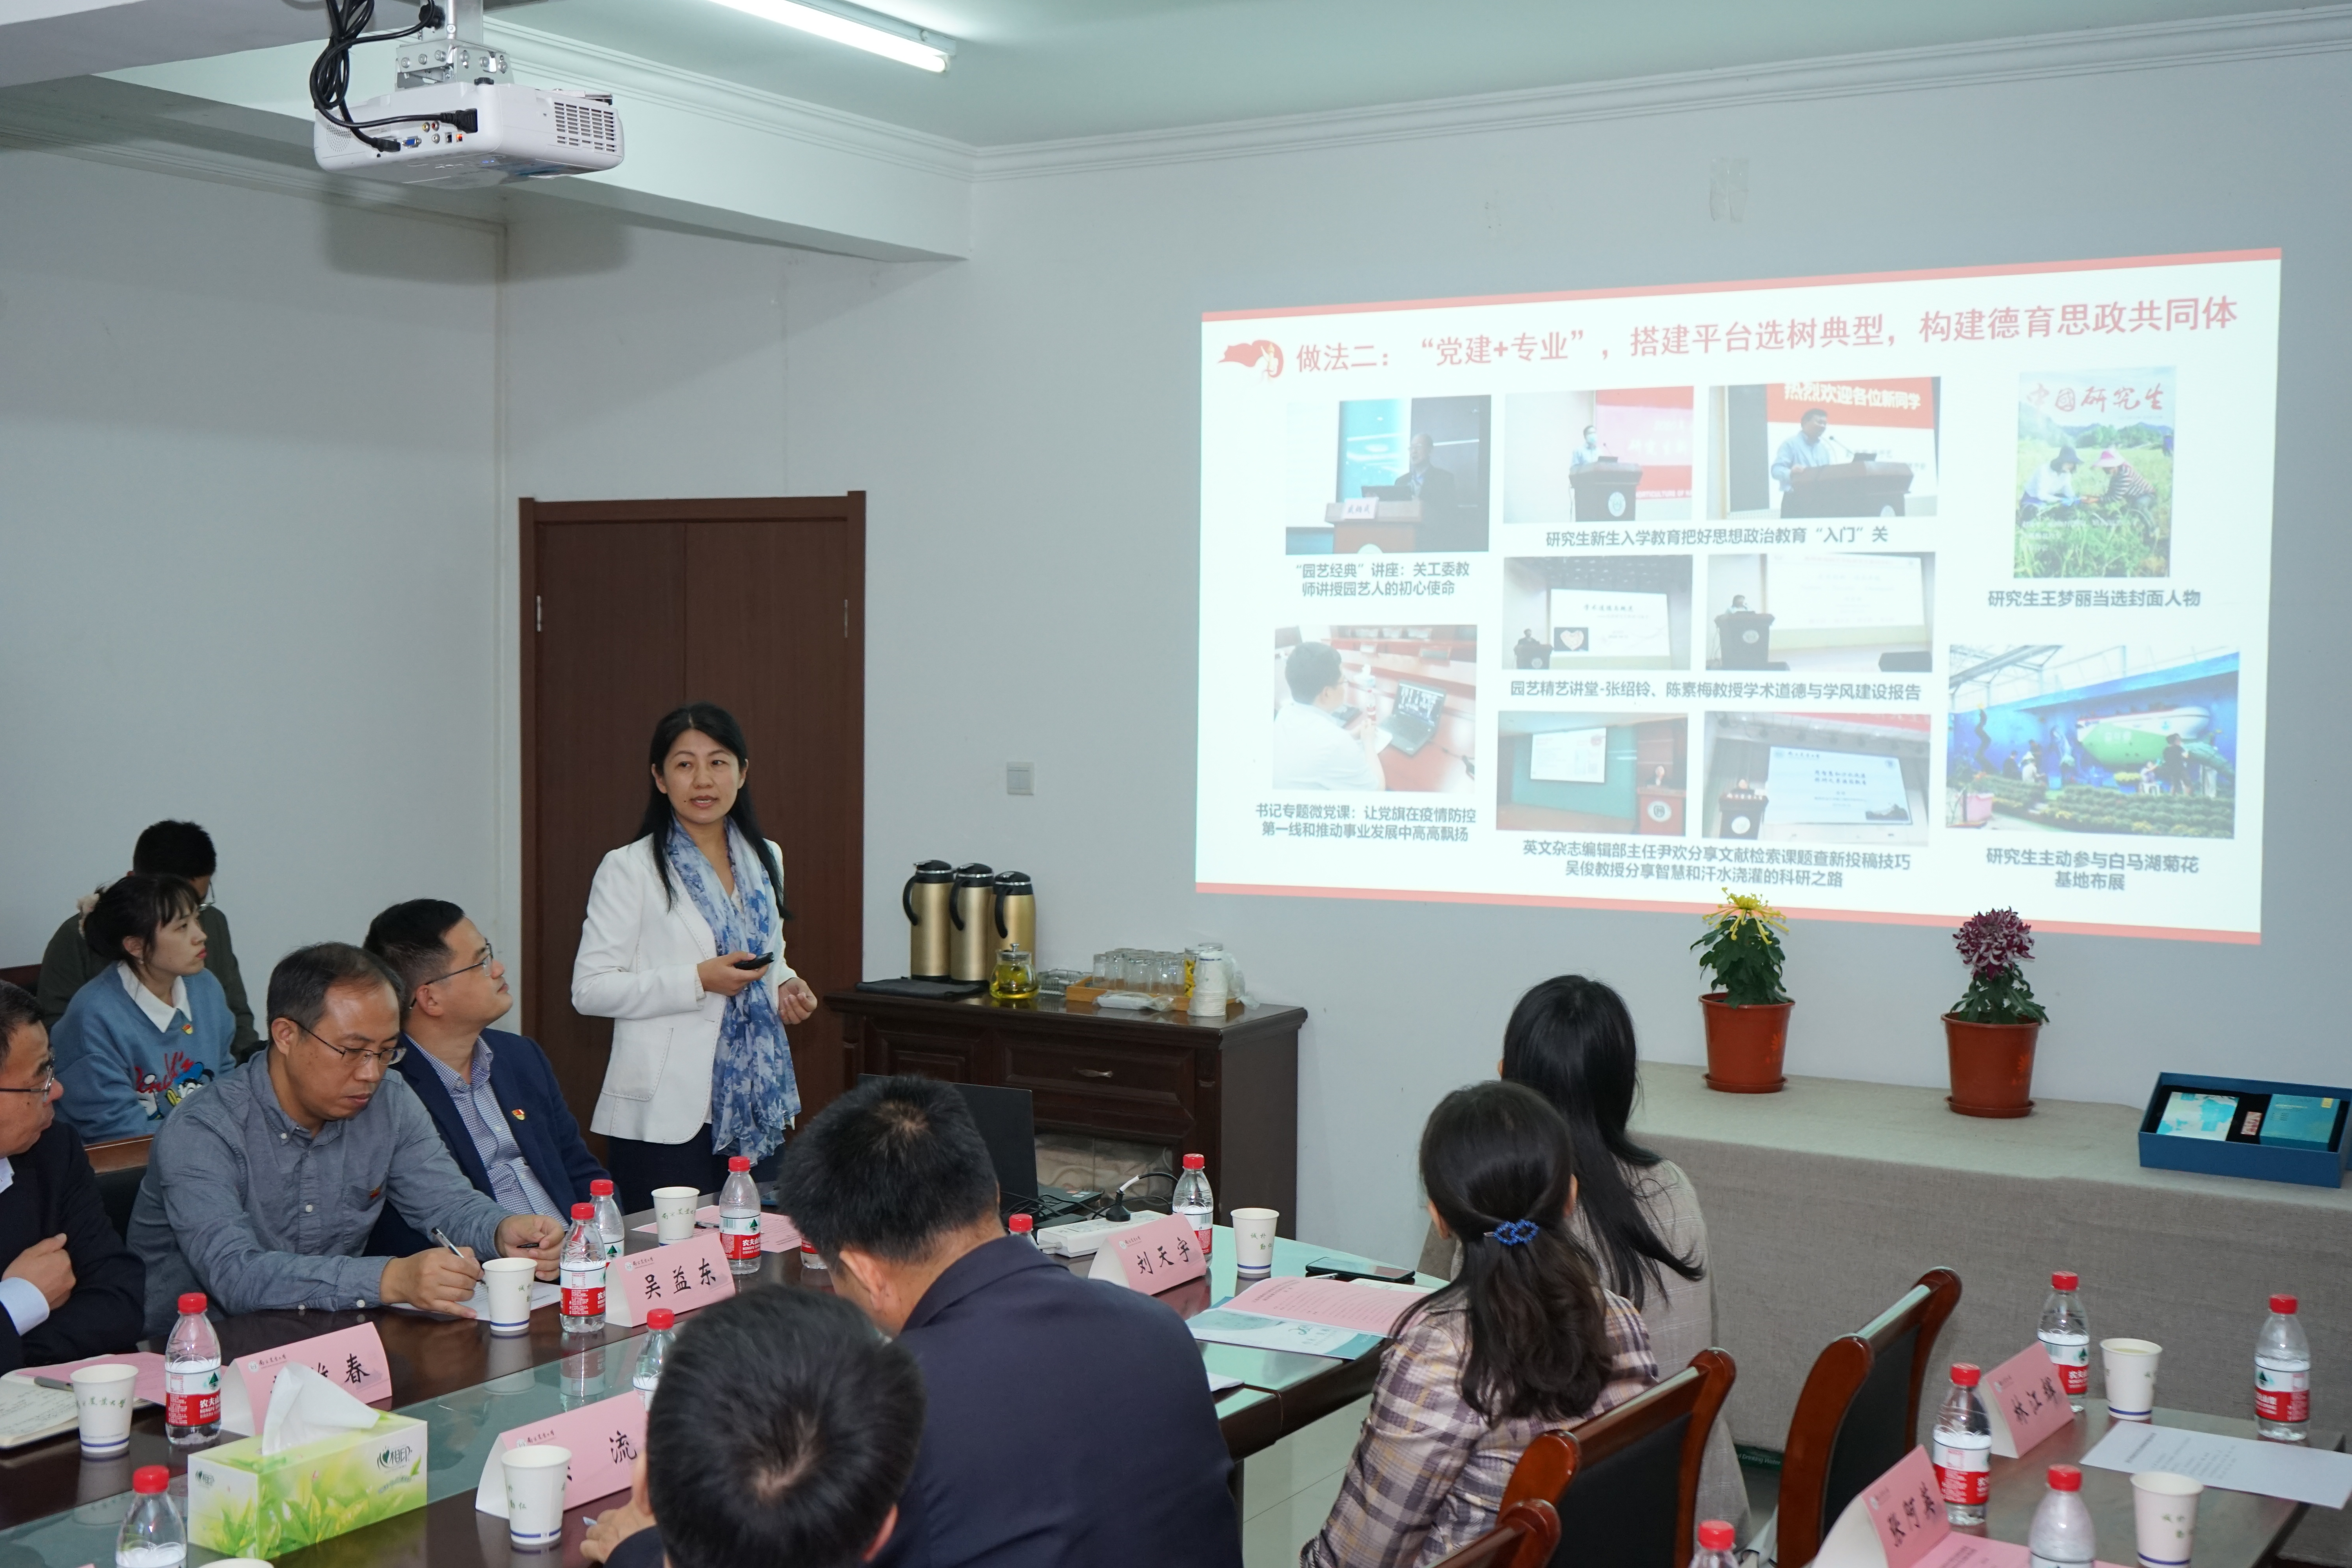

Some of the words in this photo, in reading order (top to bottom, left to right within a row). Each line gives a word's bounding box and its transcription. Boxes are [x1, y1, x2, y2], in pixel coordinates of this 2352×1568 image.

[1784, 382, 1921, 410] 热烈欢迎各位新同学
[1302, 580, 1455, 597] 师讲授园艺人的初心使命
[1987, 589, 2202, 608] 研究生王梦丽当选封面人物
[1255, 803, 1477, 823] 书记专题微党课：让党旗在疫情防控
[1261, 820, 1469, 842] 第一线和推动事业发展中高高飘扬
[1523, 840, 1911, 870] 英文杂志编辑部主任尹欢分享文献检索课题查新投稿技巧
[1985, 848, 2200, 874] 研究生主动参与白马湖菊花
[1564, 860, 1844, 888] 吴俊教授分享智慧和汗水浇灌的科研之路
[2054, 871, 2126, 891] 基地布展
[1137, 1236, 1190, 1274] 刘天宇
[644, 1258, 716, 1299] 吴益东
[200, 1395, 222, 1409] 农夫山
